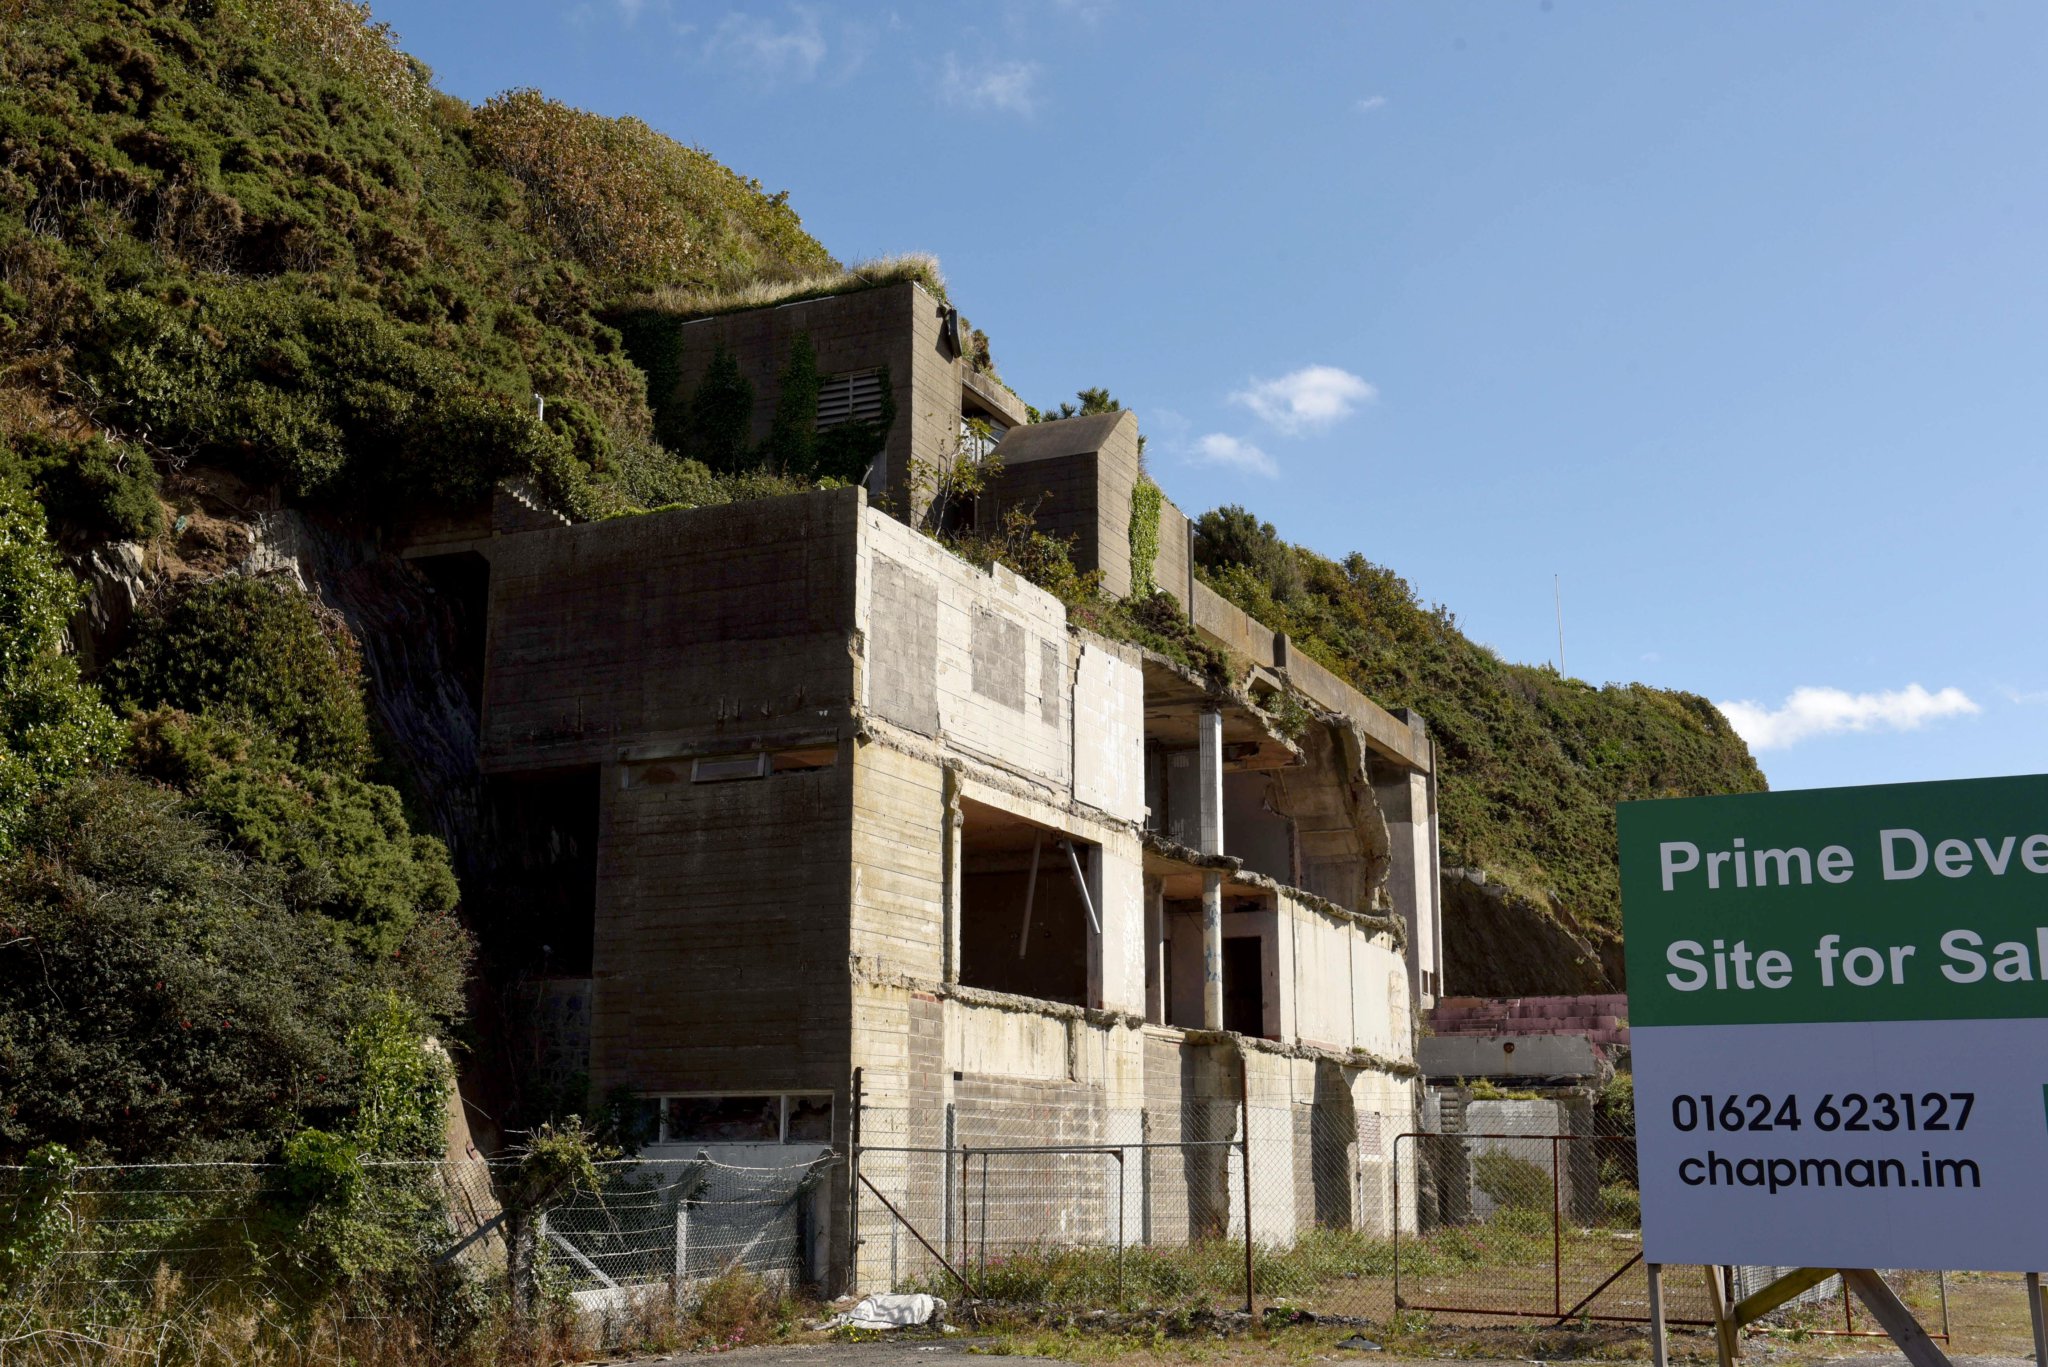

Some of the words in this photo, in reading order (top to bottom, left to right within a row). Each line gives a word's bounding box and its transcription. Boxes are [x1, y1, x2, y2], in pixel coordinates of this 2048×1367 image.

[1660, 838, 1854, 891] Prime
[1880, 828, 2048, 880] Deve
[1666, 940, 1792, 991] Site
[1815, 935, 1915, 987] for
[1940, 927, 2048, 983] Sal
[1672, 1094, 1801, 1131] 01624
[1814, 1093, 1975, 1131] 623127
[1679, 1151, 1981, 1194] chapman.im
